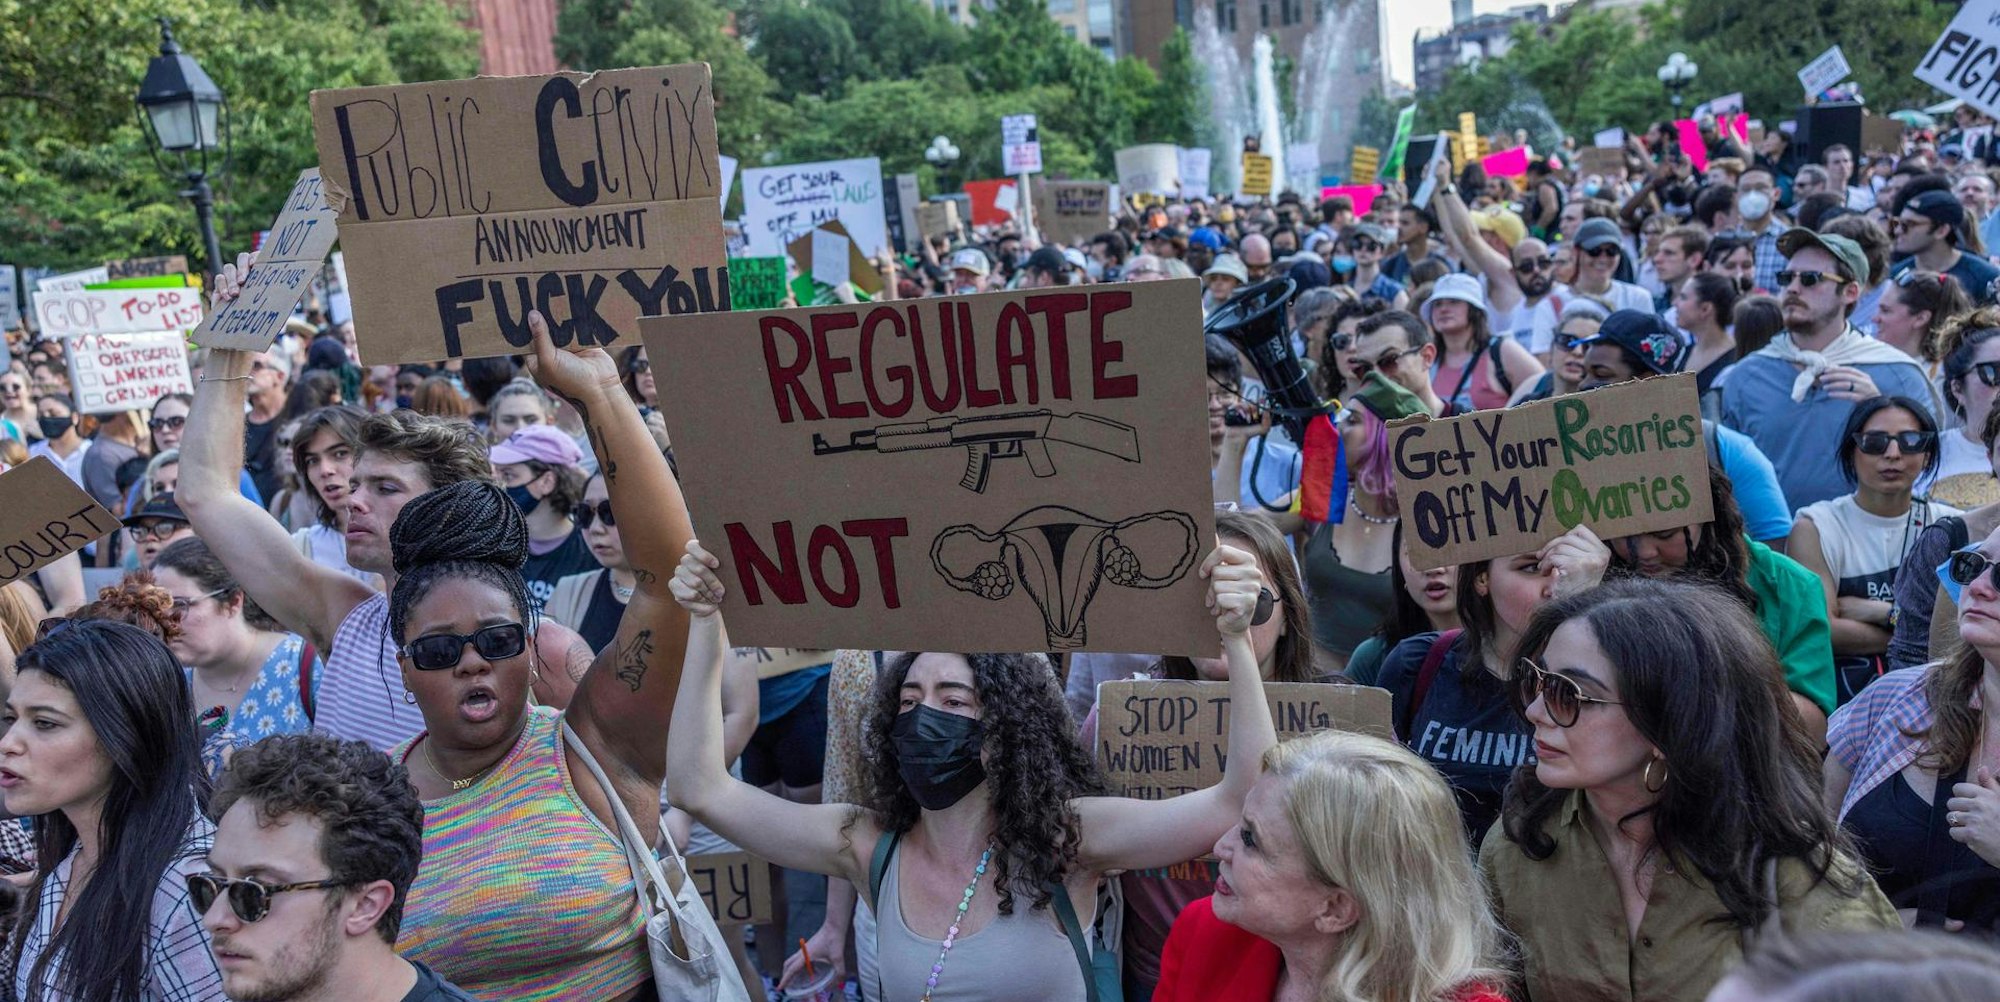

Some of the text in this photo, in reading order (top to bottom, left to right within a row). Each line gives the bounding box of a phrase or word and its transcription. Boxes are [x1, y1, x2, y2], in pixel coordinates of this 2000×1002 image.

[335, 77, 711, 220] Public Cervix
[759, 173, 797, 199] GET
[801, 169, 845, 191] YOUR
[270, 219, 318, 259] NOT
[475, 208, 648, 265] ANNOUNCMENT
[767, 211, 797, 231] OFF
[245, 263, 305, 304] religious
[42, 291, 181, 329] GOP TO-DO
[161, 303, 202, 329] LIST
[209, 298, 280, 337] freedom
[435, 264, 731, 357] FUCK YOU
[101, 364, 182, 386] LAWRENCE
[759, 291, 1138, 423] REGULATE
[1394, 399, 1696, 480] Get Your Rosaries
[1413, 469, 1691, 549] Off My Ovaries
[724, 517, 908, 609] NOT
[1867, 581, 1895, 597] BA
[1119, 695, 1198, 737] STOP
[1103, 740, 1200, 773] WOMEN
